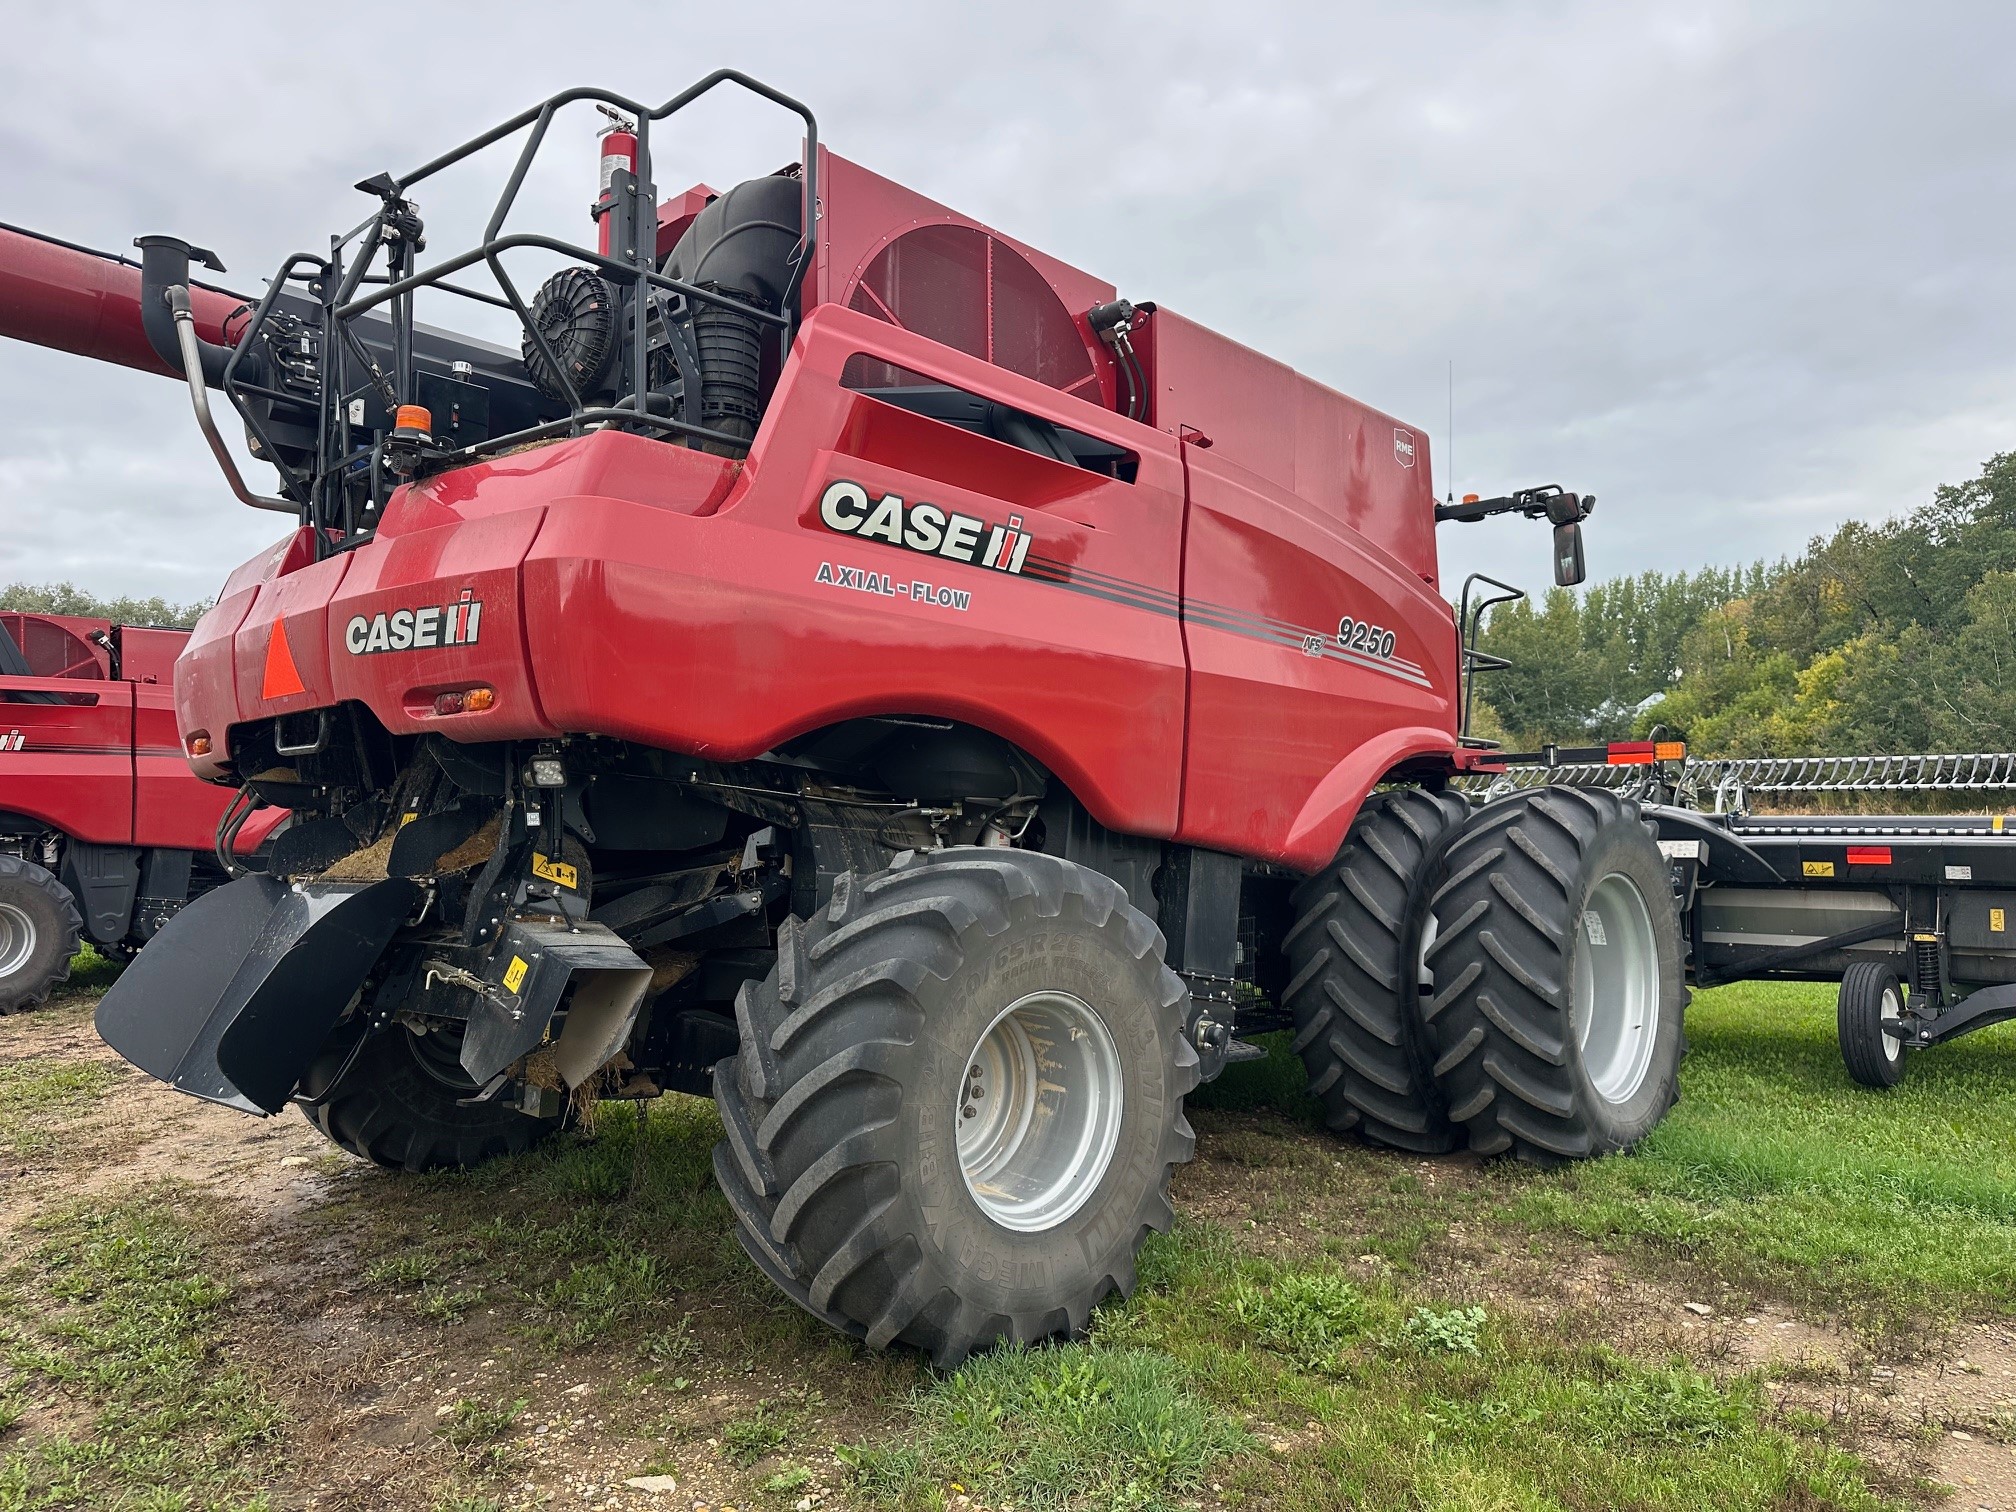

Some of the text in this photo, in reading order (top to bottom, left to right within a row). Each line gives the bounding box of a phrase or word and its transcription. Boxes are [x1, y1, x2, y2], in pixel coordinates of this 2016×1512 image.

[1396, 440, 1413, 456] RME
[820, 480, 984, 562] CASE
[815, 562, 971, 611] AXIAL-FLOW
[345, 606, 441, 655] CASE
[1303, 636, 1322, 651] AFS
[1338, 616, 1395, 659] 9250
[1079, 1062, 1163, 1267] MICHELIN
